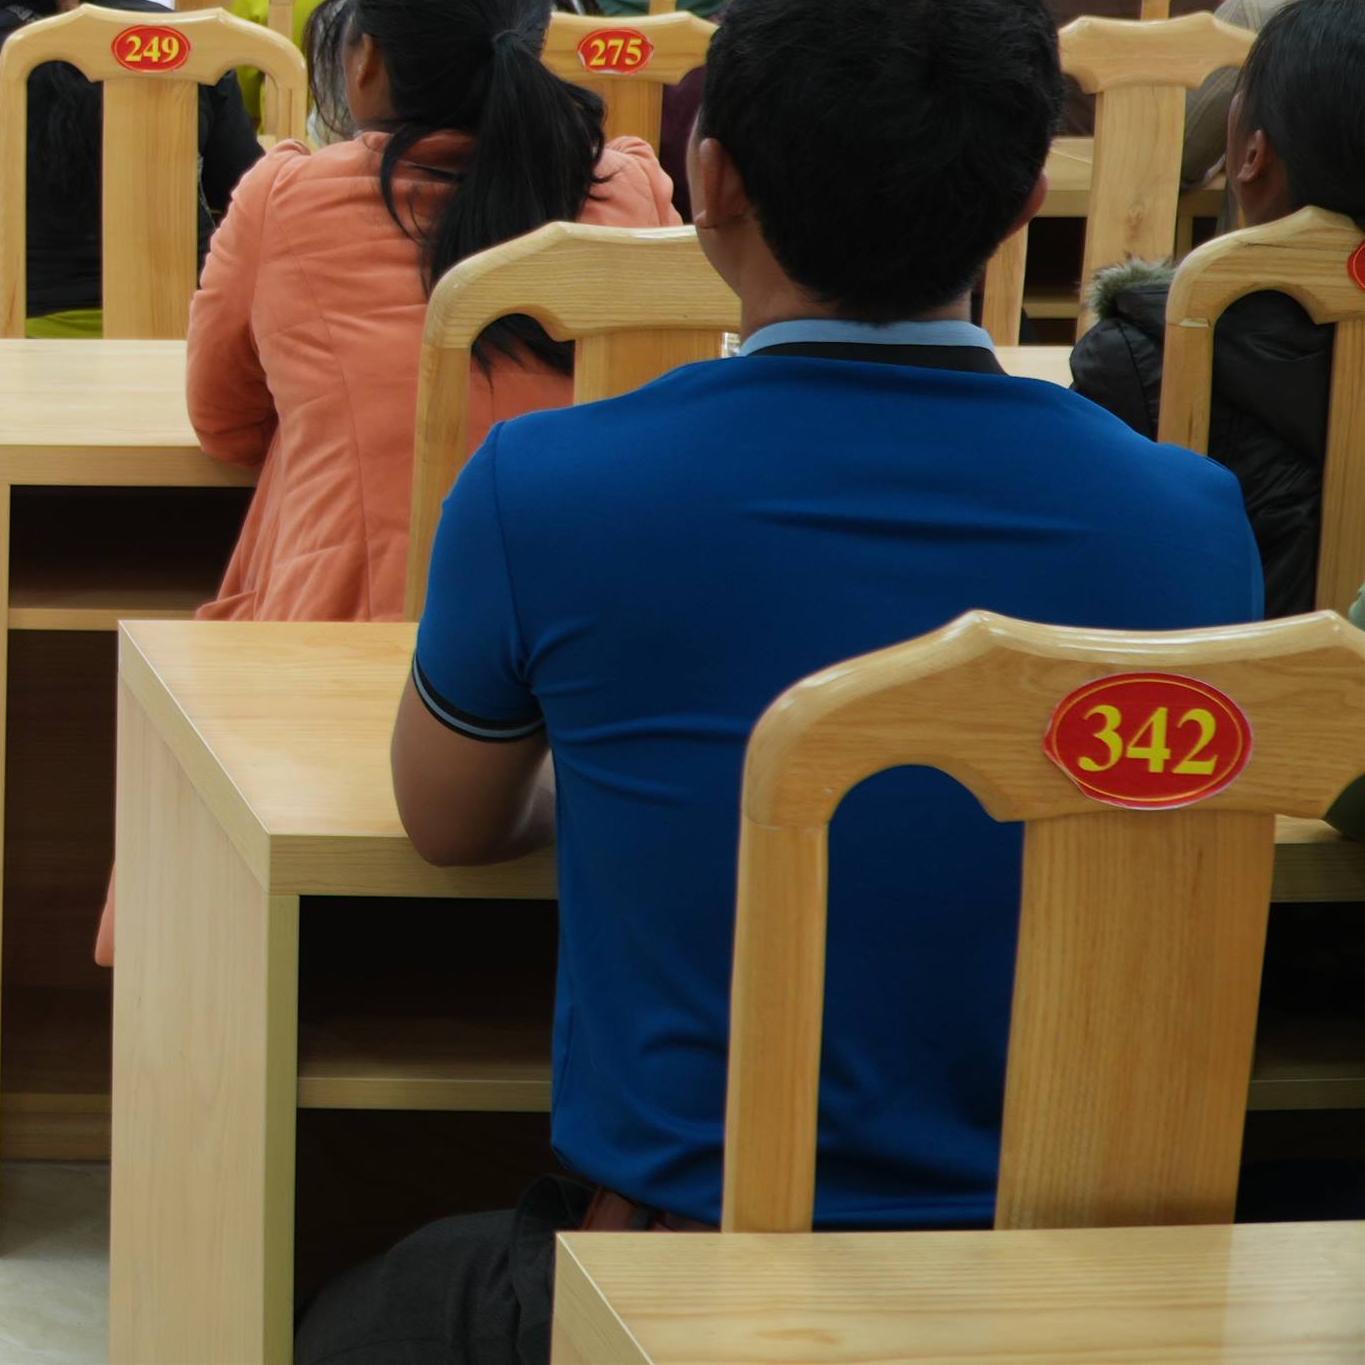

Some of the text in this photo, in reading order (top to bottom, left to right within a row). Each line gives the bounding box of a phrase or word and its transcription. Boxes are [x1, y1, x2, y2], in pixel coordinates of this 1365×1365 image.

[124, 35, 180, 63] 249
[589, 38, 642, 66] 275
[1077, 704, 1218, 776] 342
